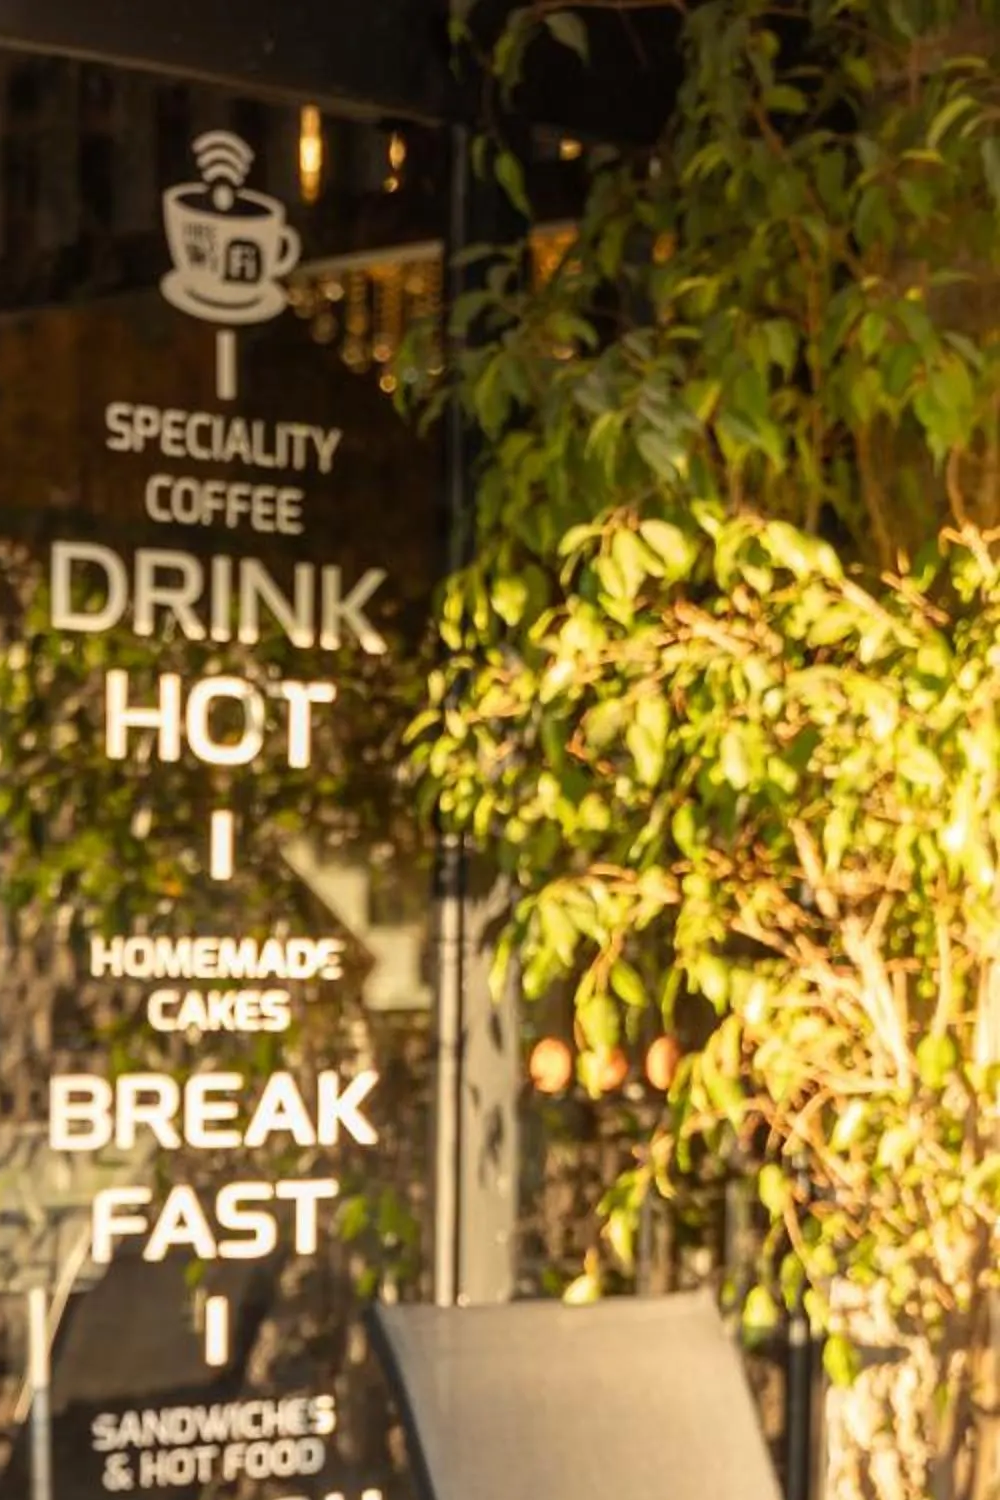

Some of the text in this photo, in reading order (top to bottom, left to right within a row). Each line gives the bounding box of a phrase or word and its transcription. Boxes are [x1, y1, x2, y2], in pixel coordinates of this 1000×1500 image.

[105, 401, 343, 474] SPECIALITY
[145, 473, 305, 535] COFFEE
[50, 540, 388, 655] DRINK
[105, 669, 338, 770] HOT
[90, 935, 345, 980] HOMEMADE
[147, 988, 291, 1032] CAKES
[50, 1070, 379, 1150] BREAK
[91, 1178, 340, 1264] FAST
[91, 1394, 337, 1451] SANDWICHES
[102, 1436, 326, 1492] & HOT FOOD
